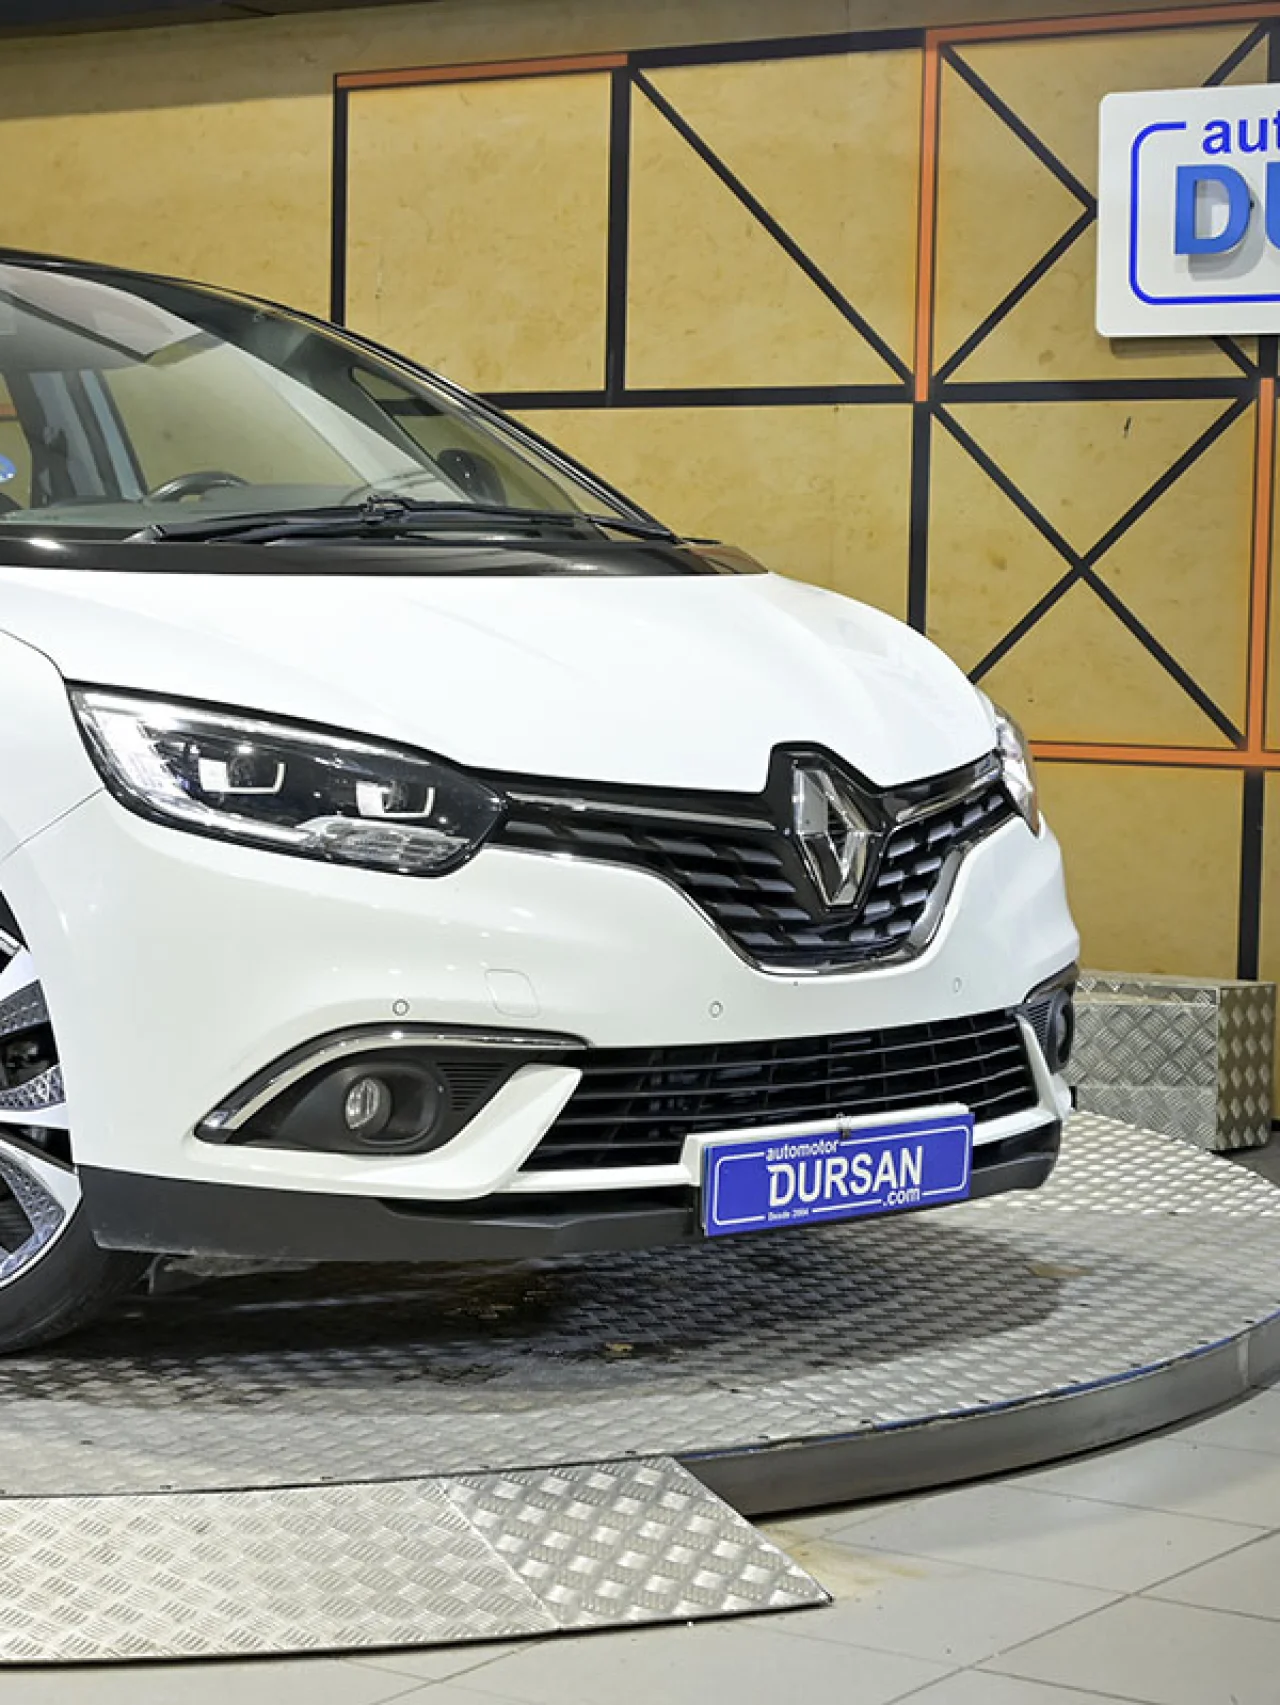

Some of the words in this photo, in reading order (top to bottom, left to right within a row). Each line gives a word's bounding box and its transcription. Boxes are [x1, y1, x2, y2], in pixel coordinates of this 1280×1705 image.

[1174, 161, 1280, 256] D
[766, 1139, 839, 1161] automotor
[766, 1145, 923, 1207] DURSAN
[882, 1187, 920, 1206] .com
